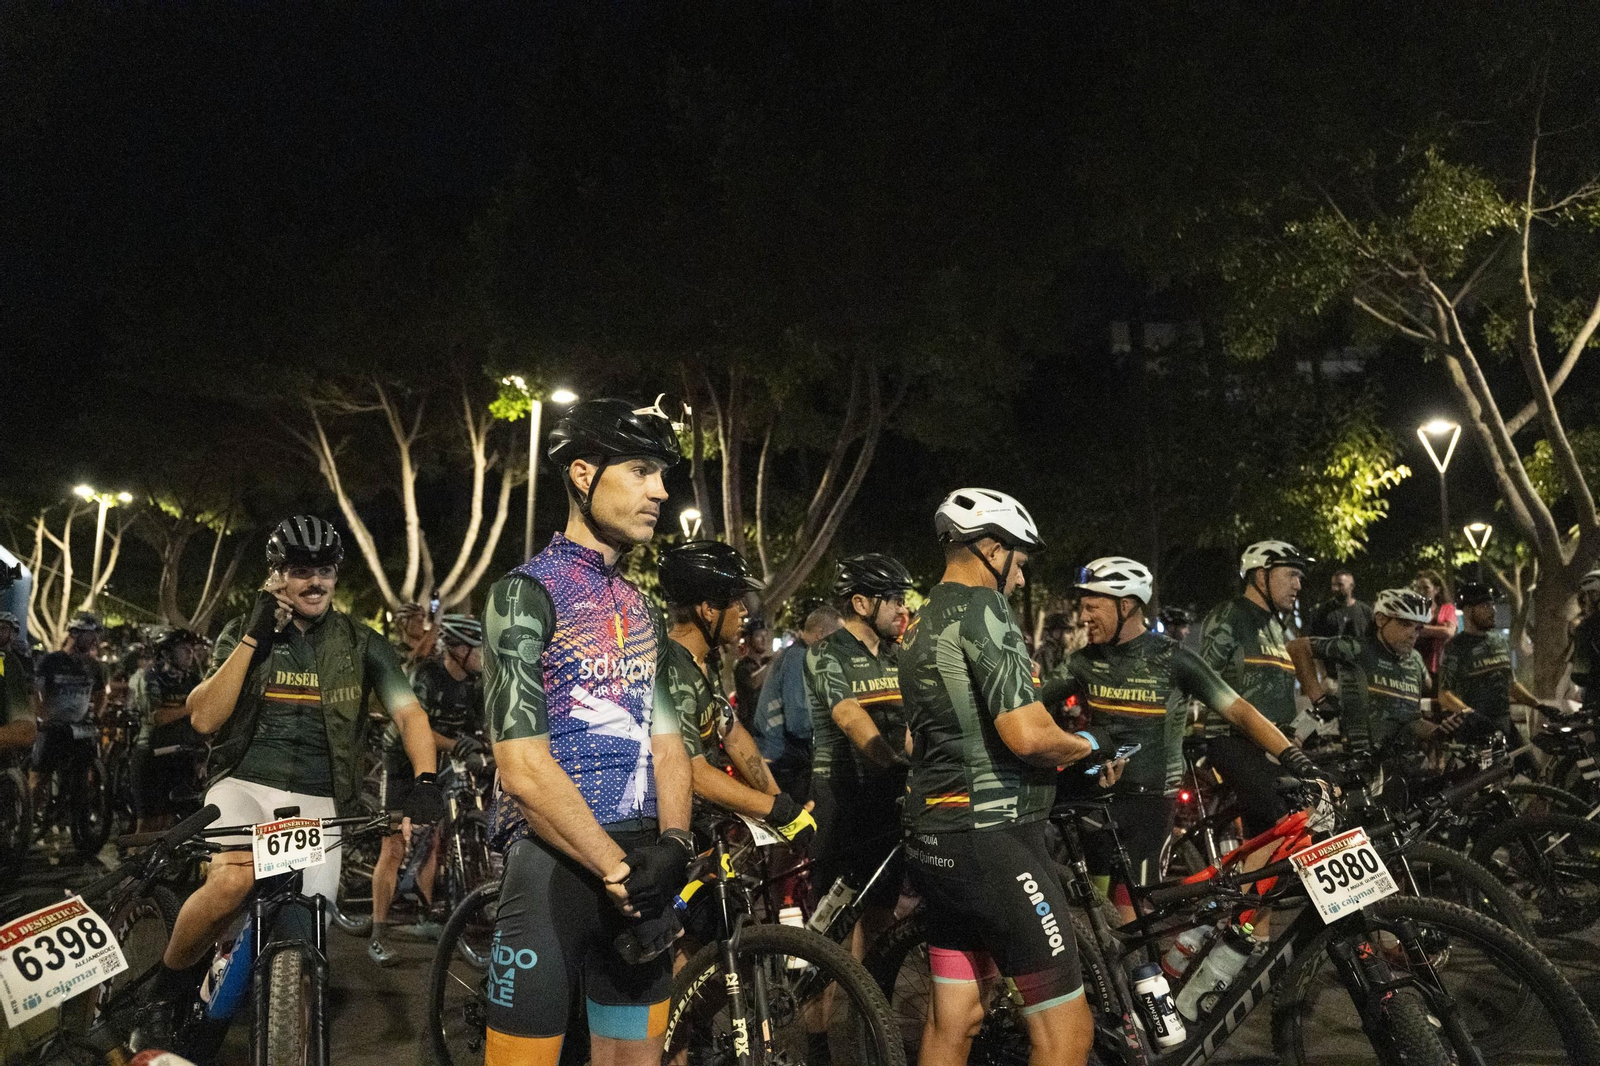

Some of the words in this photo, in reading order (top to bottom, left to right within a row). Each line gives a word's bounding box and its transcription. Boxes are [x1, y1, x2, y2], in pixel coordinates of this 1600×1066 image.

[852, 680, 867, 693] LA
[1088, 683, 1098, 696] LA
[267, 828, 321, 856] 6798
[276, 856, 308, 869] cajamar
[919, 850, 955, 869] Quintero
[1306, 853, 1317, 862] LA
[1313, 848, 1379, 895] 5980
[1341, 886, 1376, 908] cajamar
[1, 932, 18, 945] LA
[19, 904, 82, 936] DESÉRTICA
[12, 917, 108, 982] 6398
[45, 966, 98, 998] cajamar
[1145, 996, 1164, 1034] GARMIN
[732, 1017, 750, 1058] FOX
